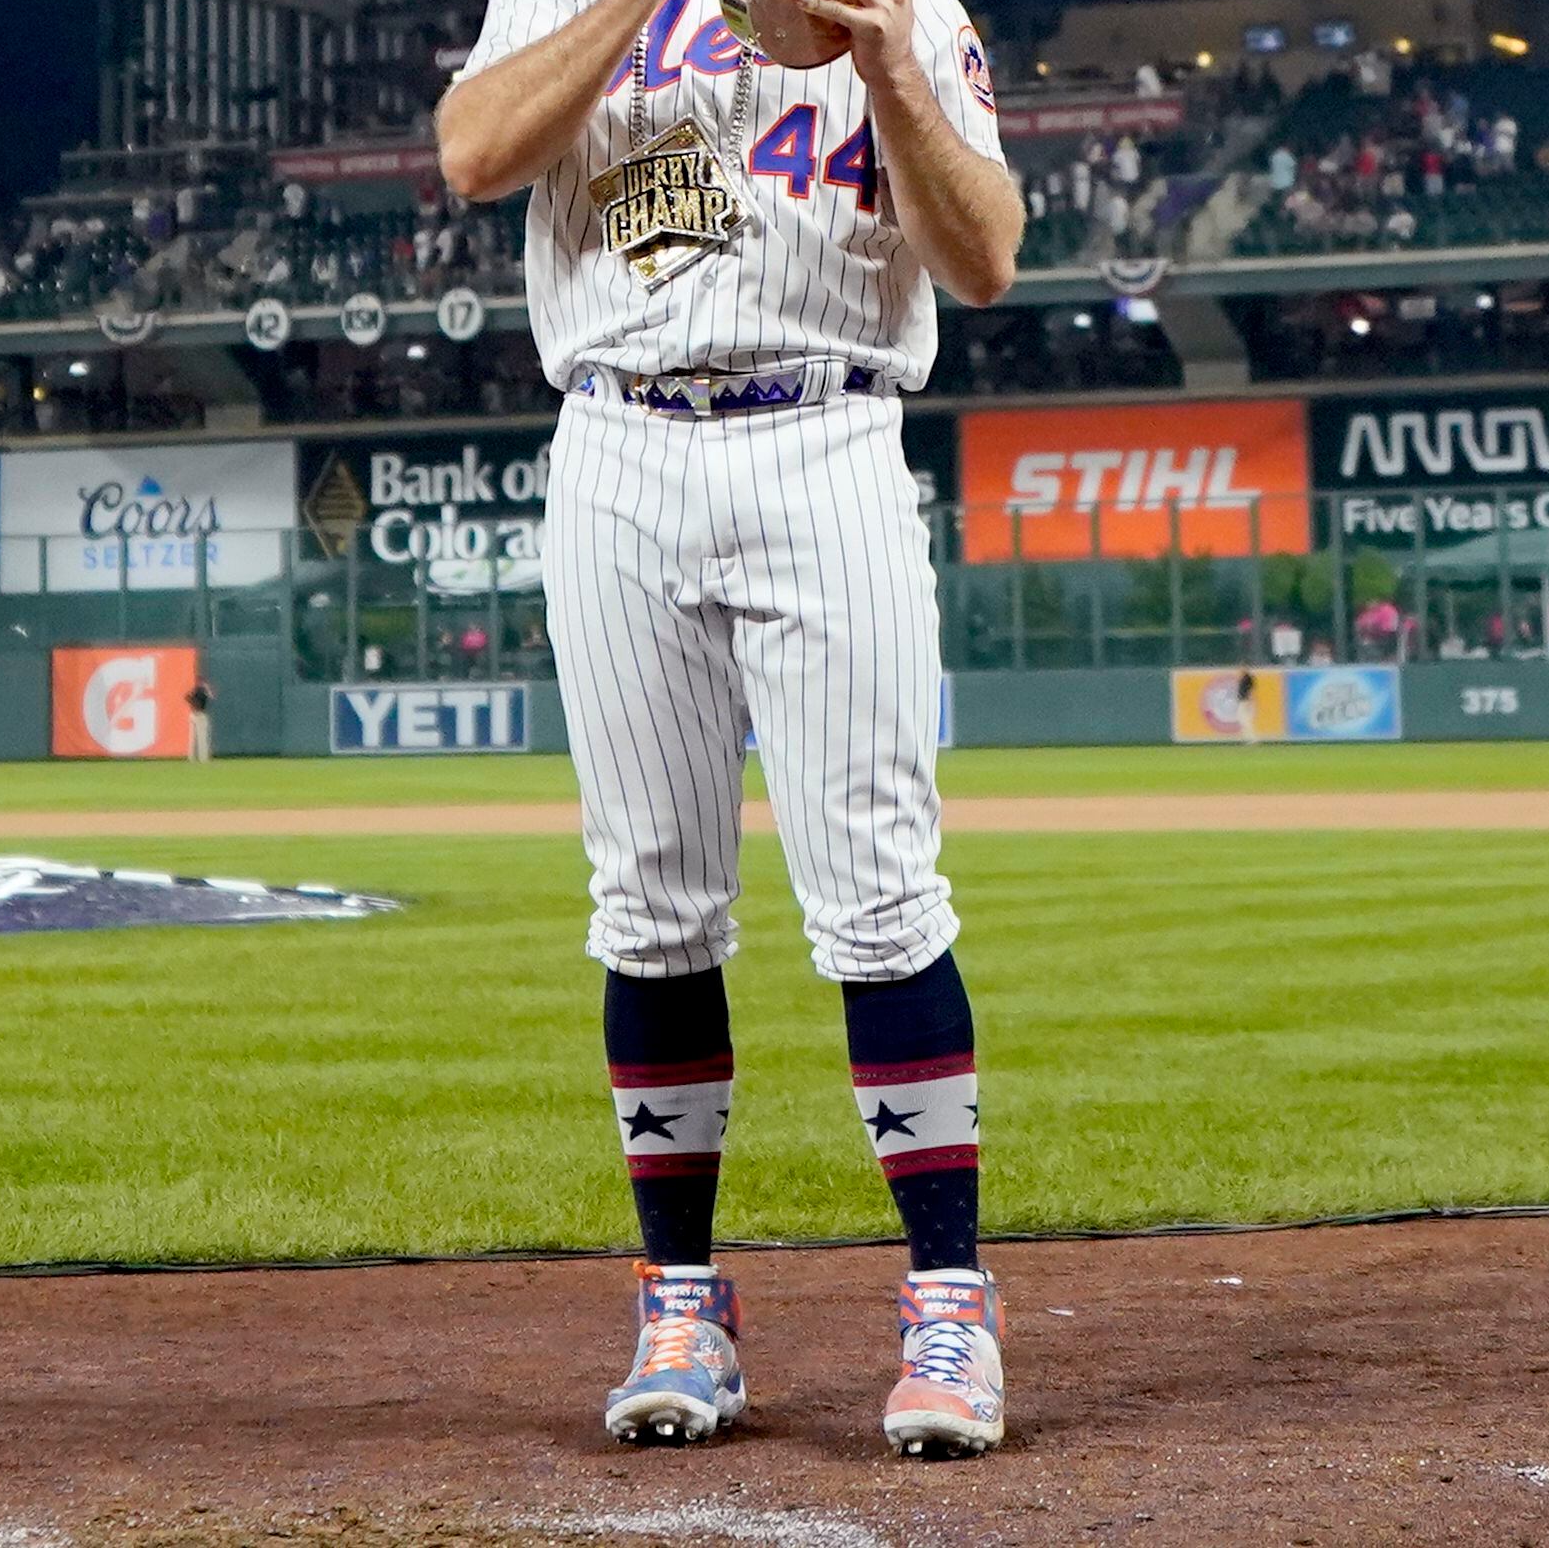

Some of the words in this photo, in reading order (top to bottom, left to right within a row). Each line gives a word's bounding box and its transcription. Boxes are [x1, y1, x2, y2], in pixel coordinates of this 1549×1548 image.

[626, 154, 698, 197] DERBY
[749, 103, 878, 213] 44
[610, 186, 726, 248] CHAMP
[371, 445, 495, 504] Bank
[1005, 447, 1262, 515] STIHL
[78, 481, 220, 541] Coors
[1343, 499, 1417, 533] Five
[1425, 496, 1529, 532] Yeas
[346, 691, 510, 748] YETI
[1460, 686, 1519, 715] 375
